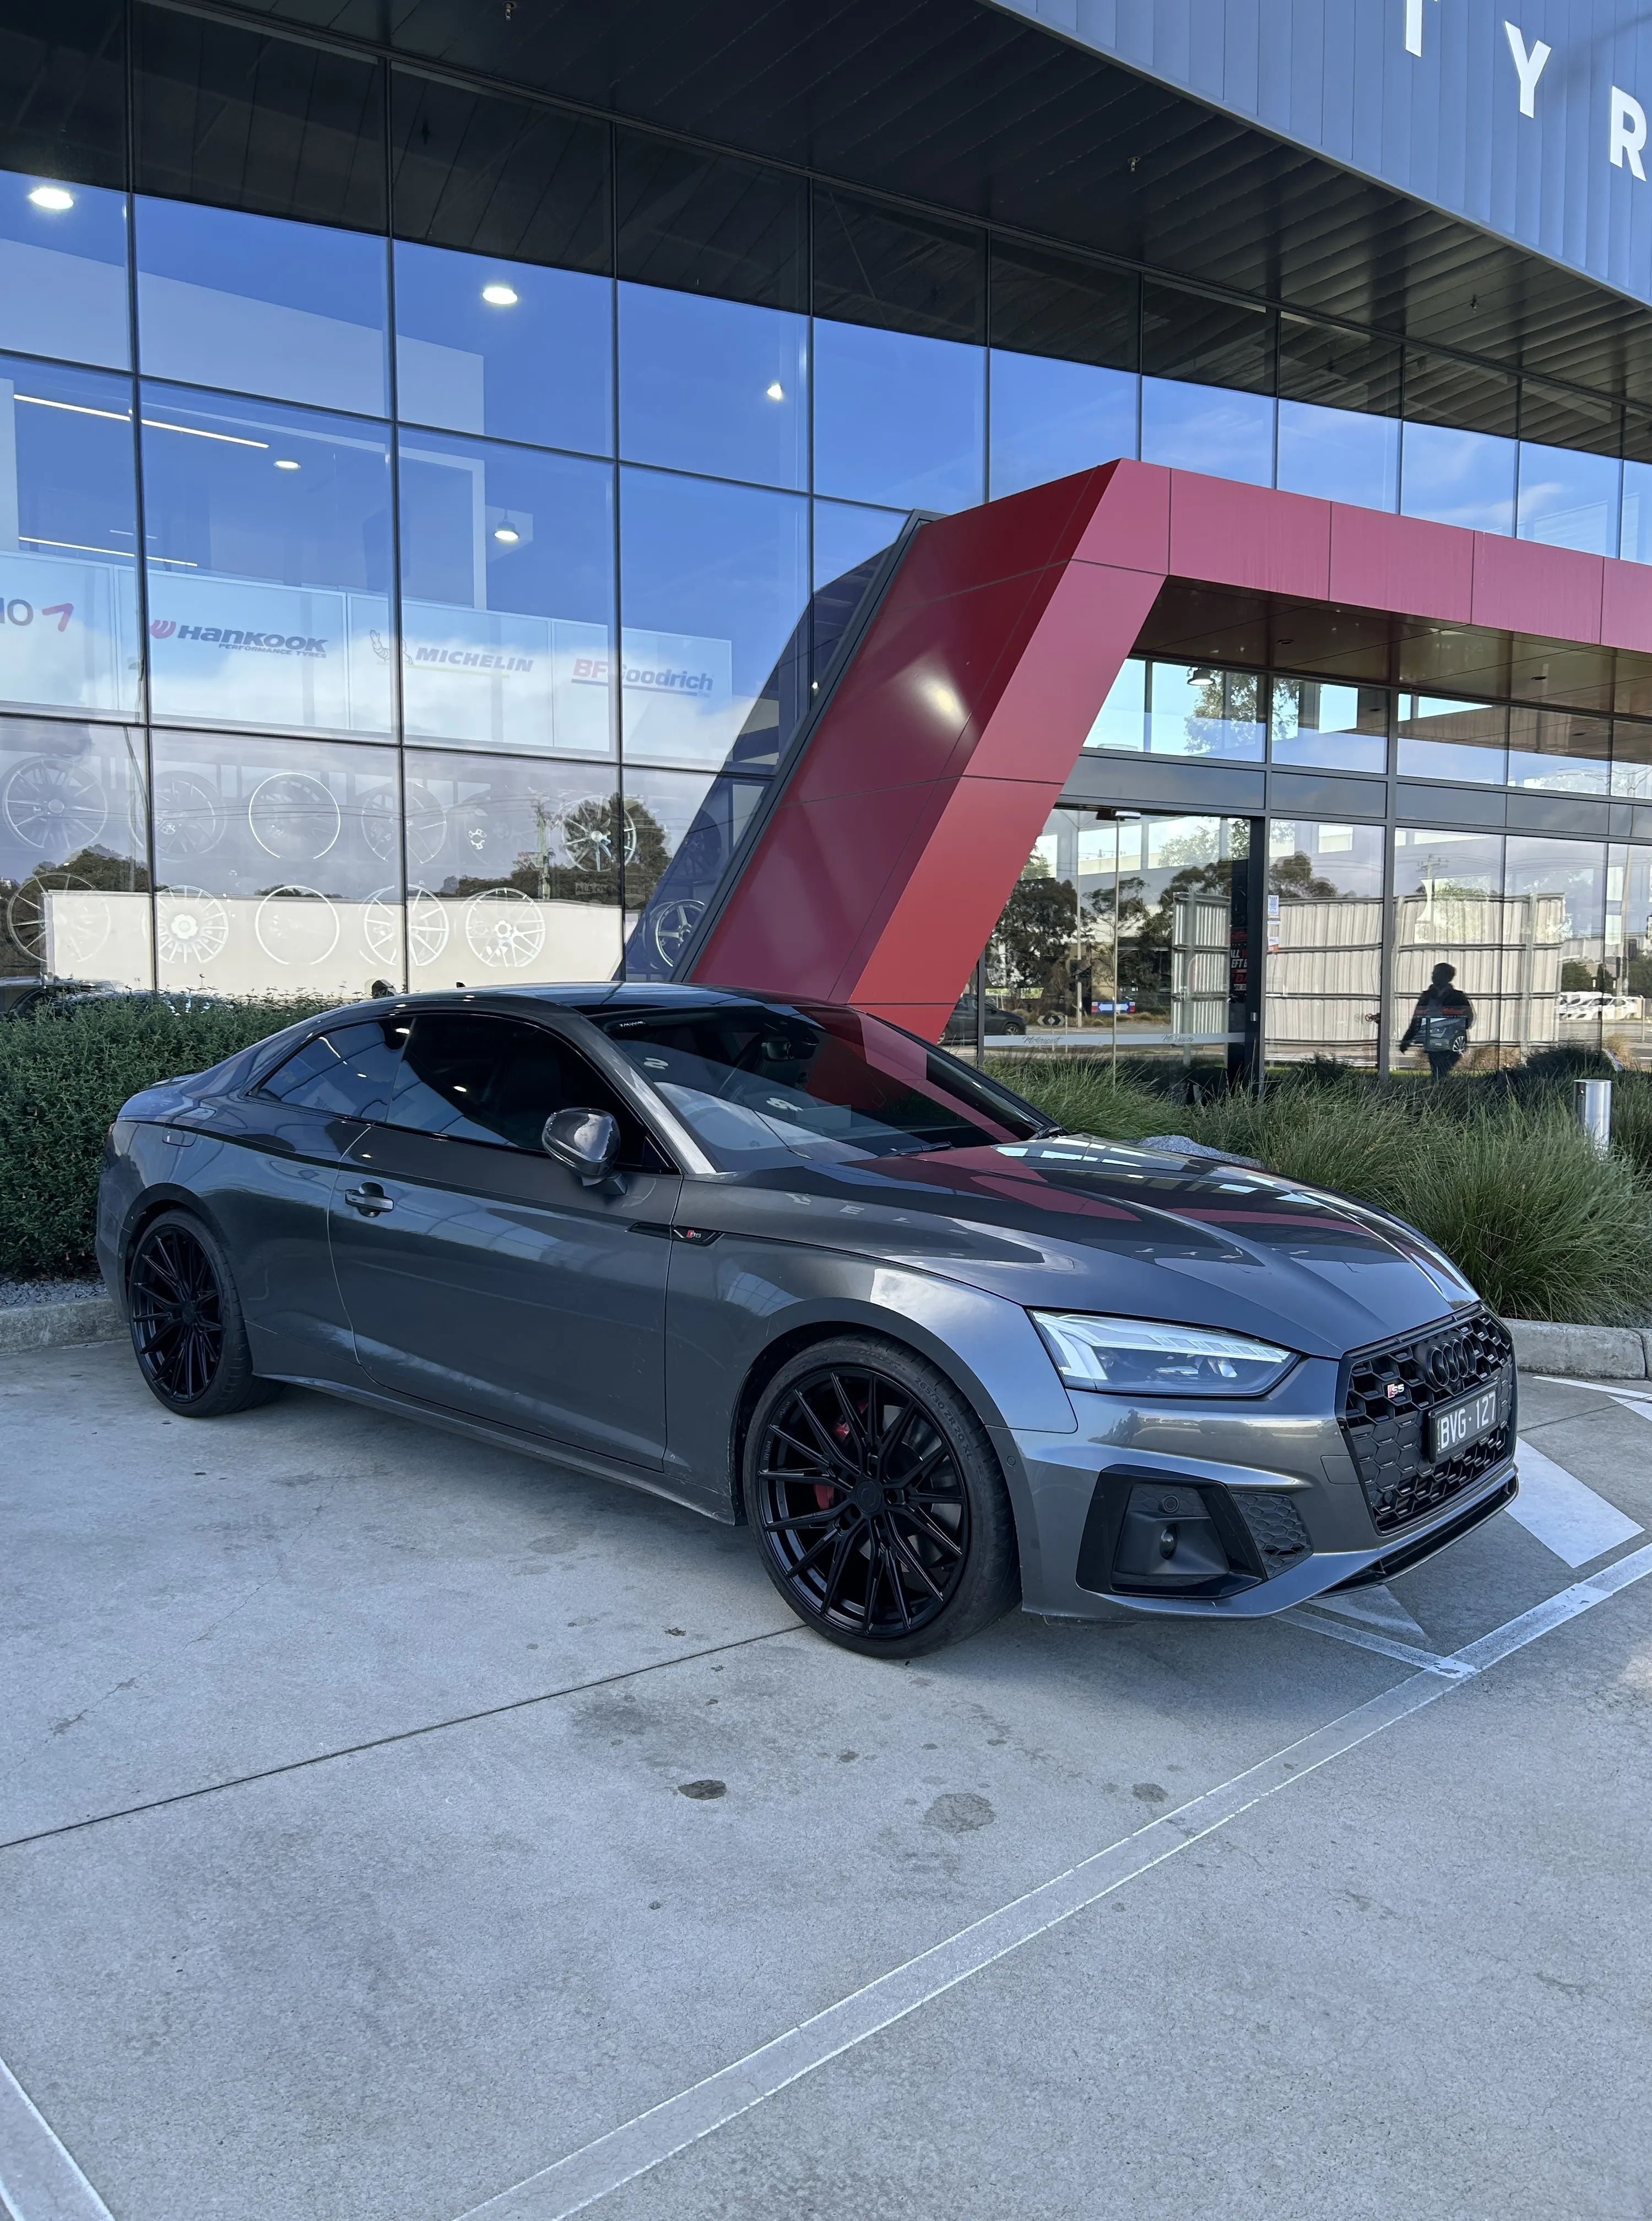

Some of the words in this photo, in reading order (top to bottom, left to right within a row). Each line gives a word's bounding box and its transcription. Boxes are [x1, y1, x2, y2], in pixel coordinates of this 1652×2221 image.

[219, 643, 292, 655] PERFORMANCE
[415, 647, 534, 673] MICHELIN
[954, 1426, 965, 1442] 20
[962, 1444, 973, 1460] XL
